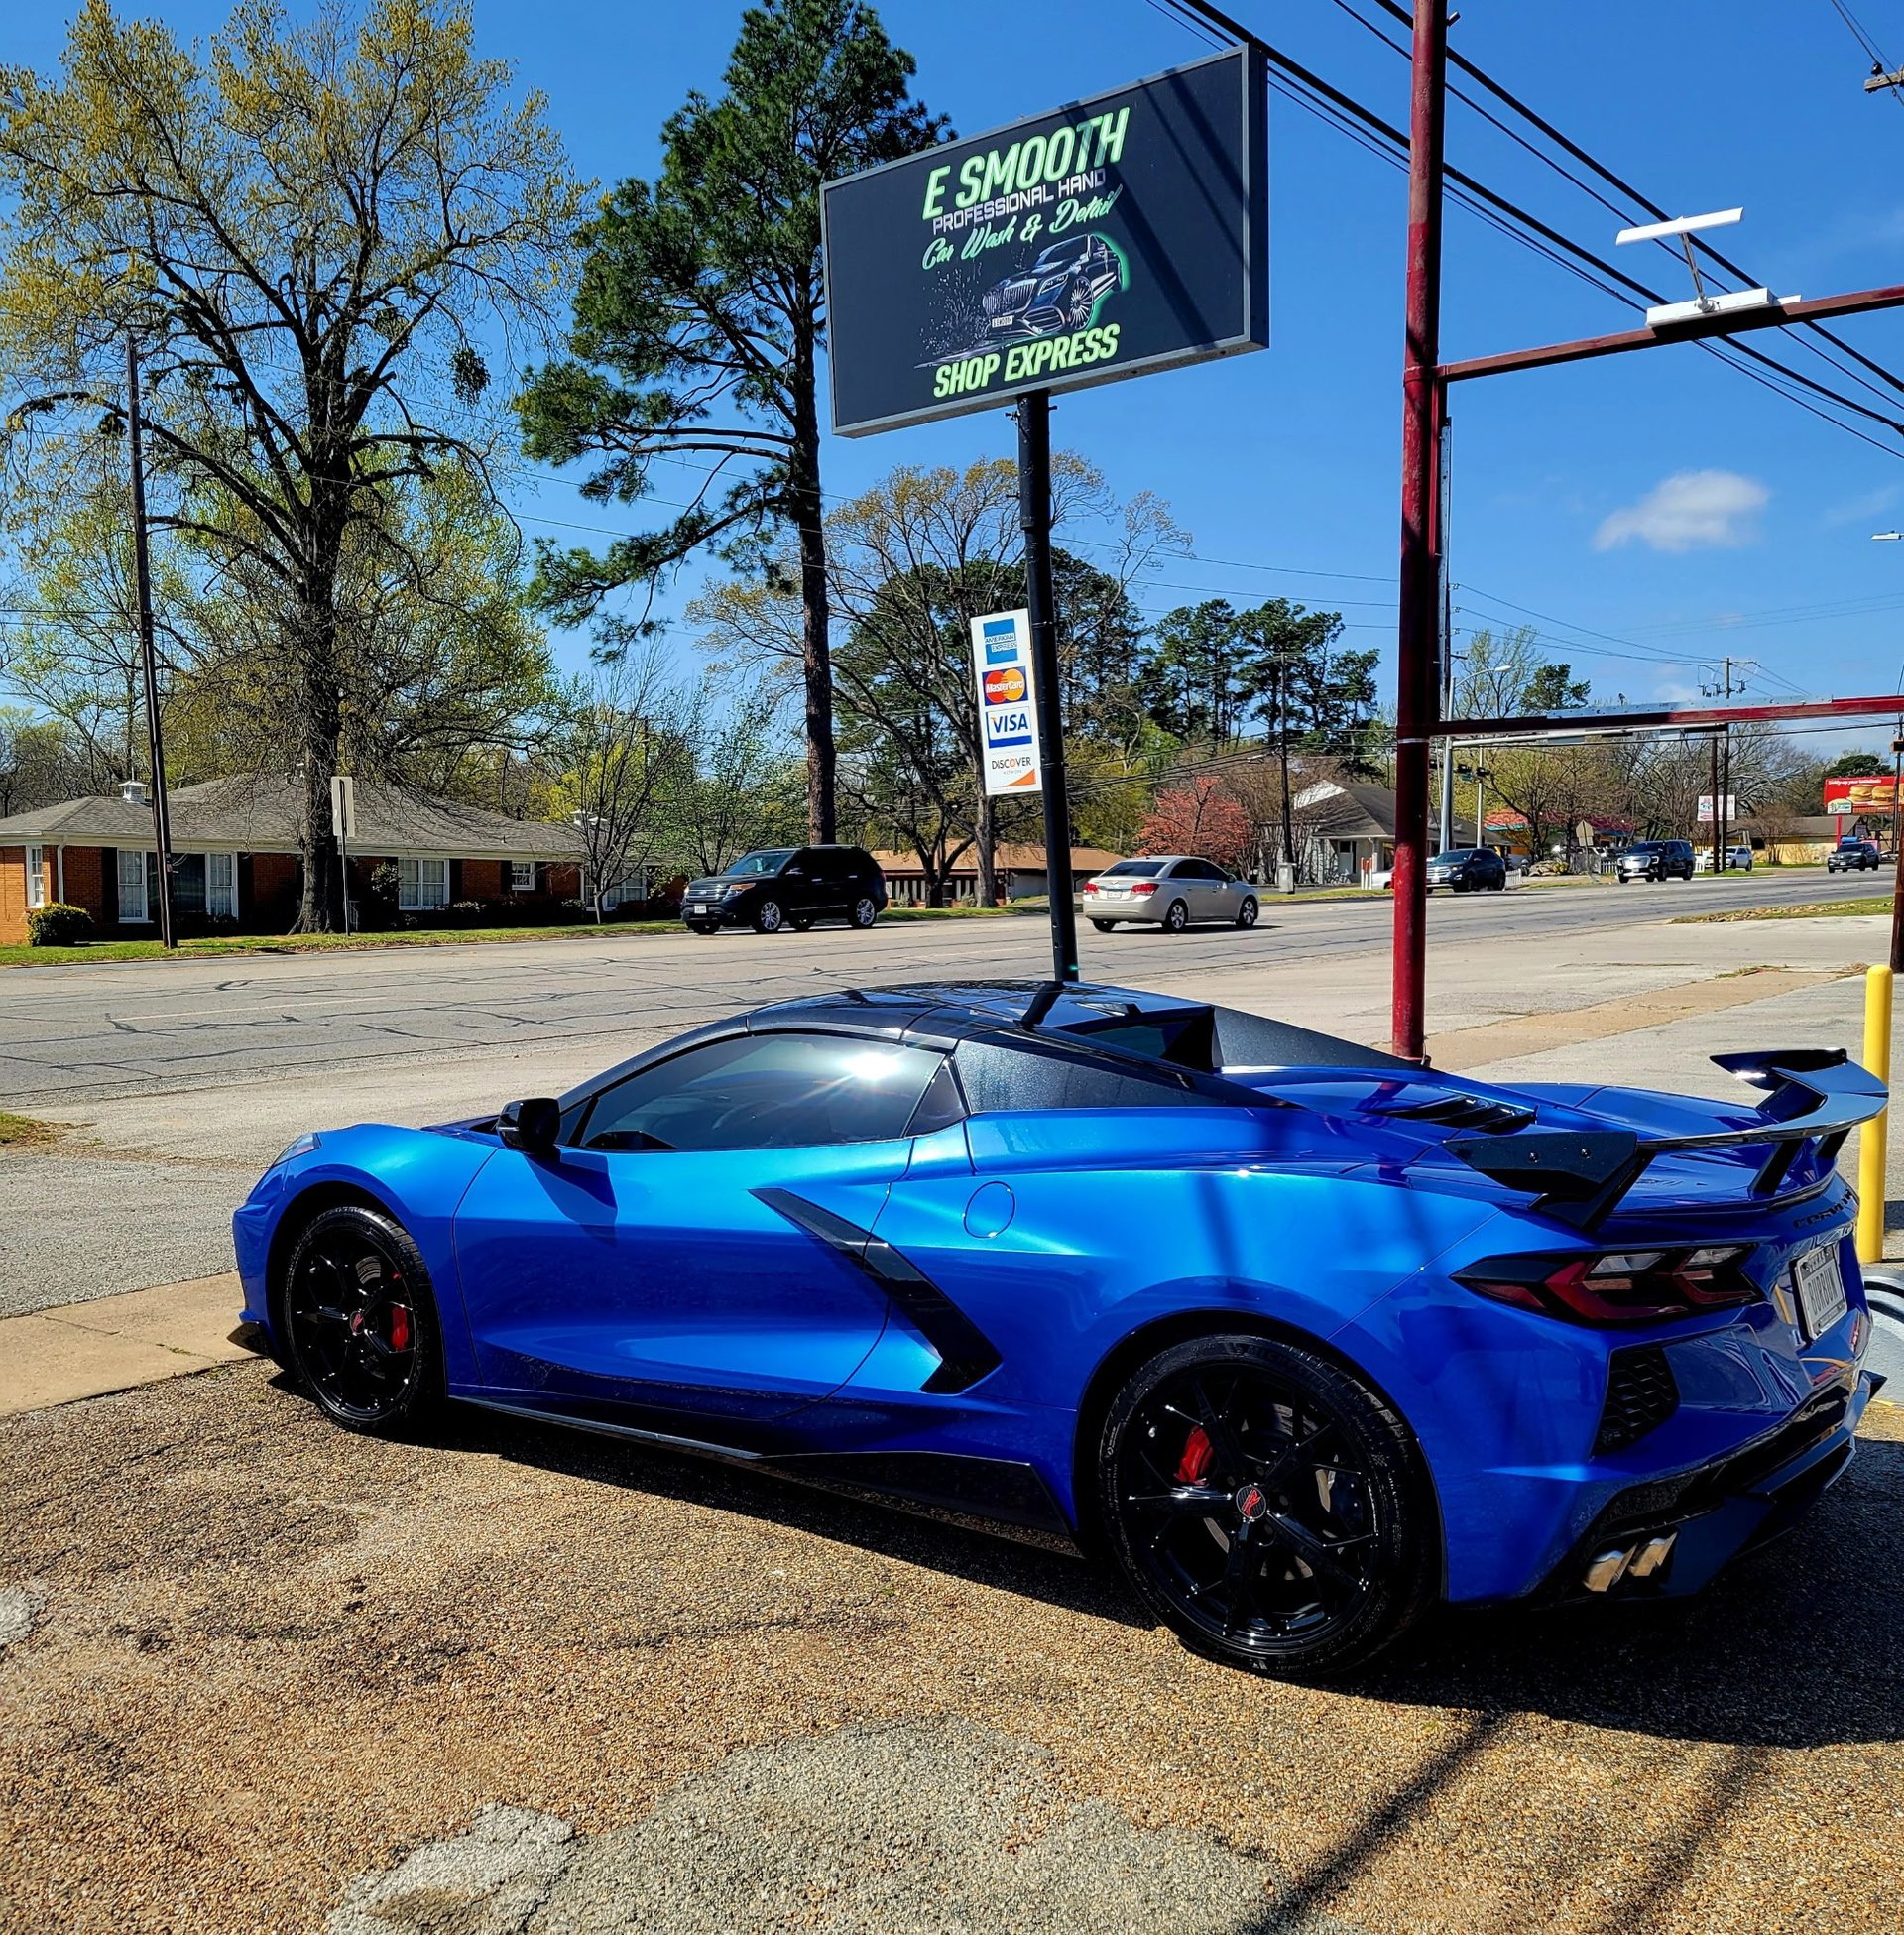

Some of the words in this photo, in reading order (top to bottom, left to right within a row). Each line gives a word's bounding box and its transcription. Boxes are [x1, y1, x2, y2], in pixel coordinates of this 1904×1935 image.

[922, 165, 951, 220] E
[955, 107, 1130, 209] SMOOTH
[933, 185, 1054, 235] PROFESSIONAL
[1058, 167, 1106, 198] HAND
[922, 237, 954, 270] Car
[960, 215, 1017, 260] Wash
[1020, 213, 1043, 242] &
[1049, 183, 1123, 234] Detail
[933, 353, 1000, 398] SHOP
[1004, 323, 1121, 382] EXPRESS
[985, 634, 1014, 644] AMERICAN
[992, 642, 1017, 652] EXPRESS
[986, 681, 1024, 693] MasterCard
[991, 713, 1029, 734] VISA
[992, 756, 1032, 770] DISCOVER
